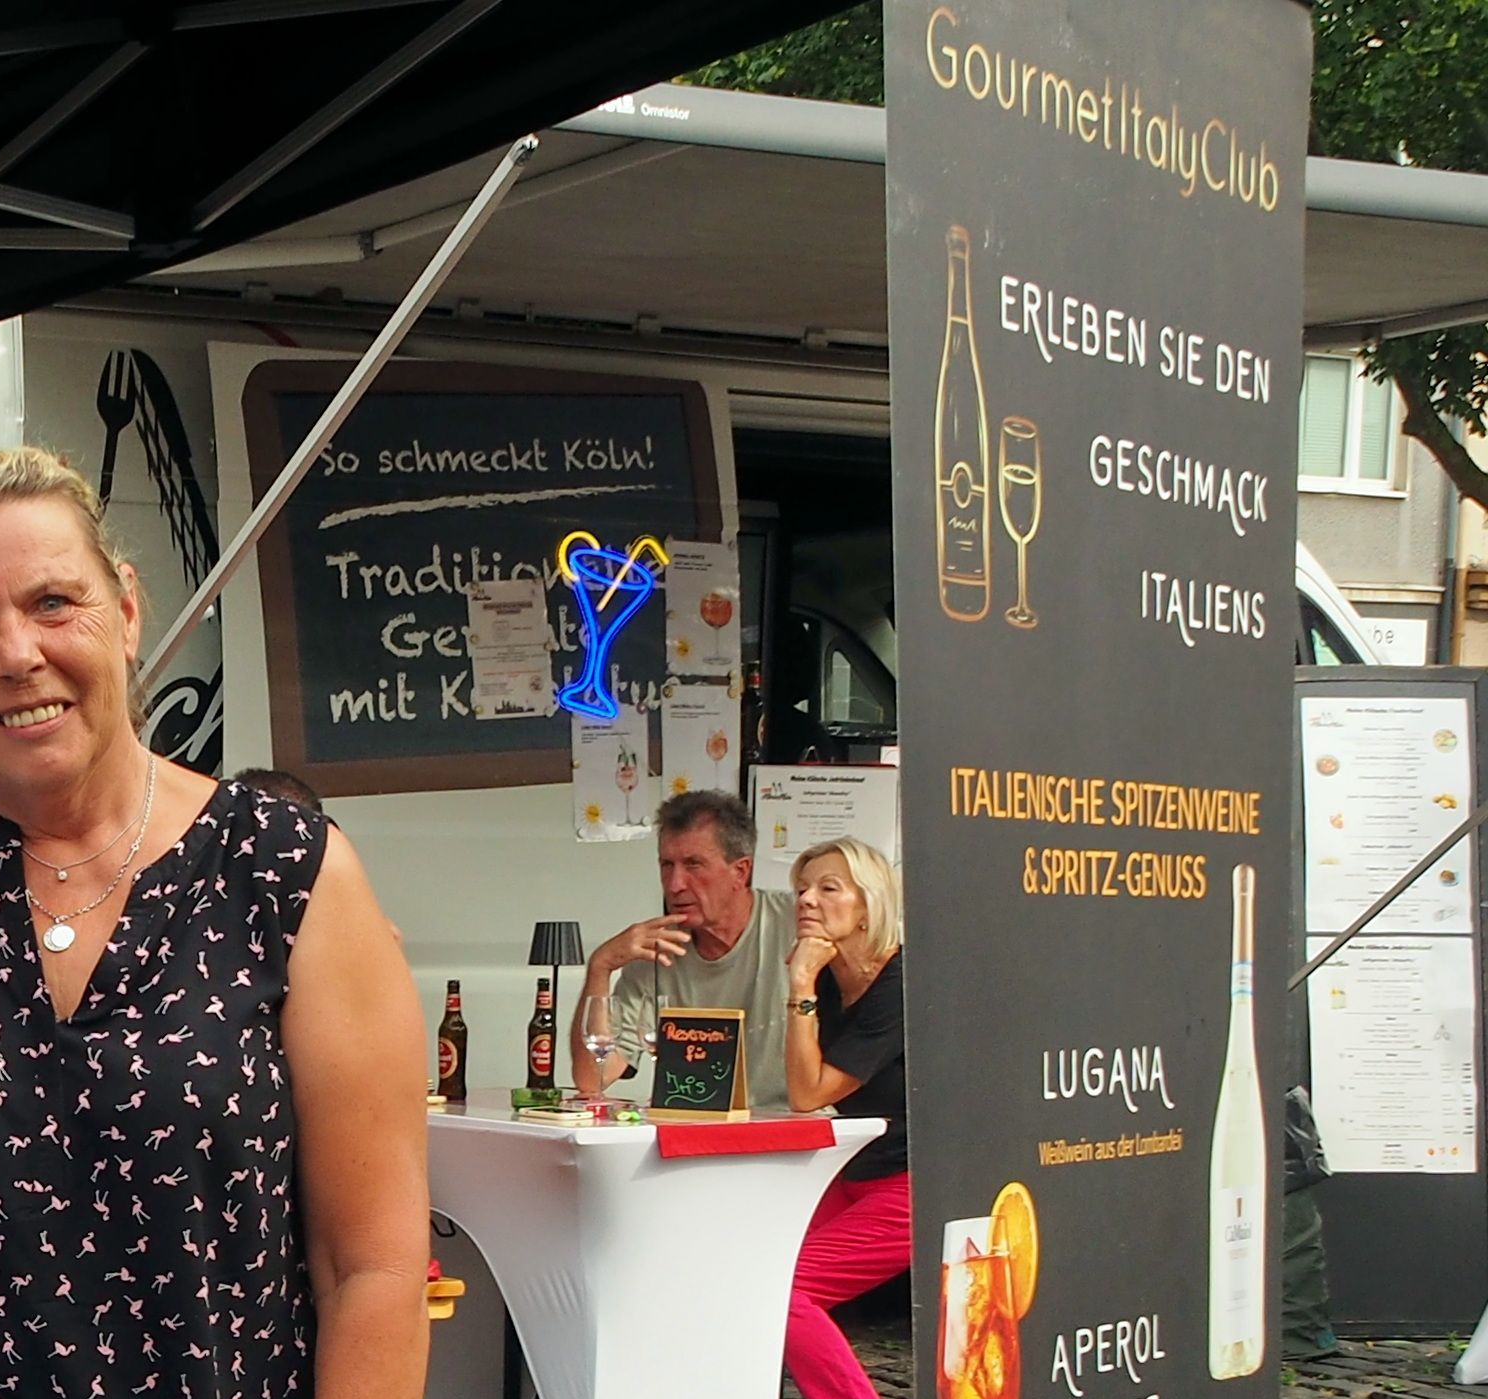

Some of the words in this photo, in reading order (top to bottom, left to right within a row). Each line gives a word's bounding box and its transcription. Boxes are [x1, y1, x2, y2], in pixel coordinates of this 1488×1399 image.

[926, 6, 1279, 212] GourmetItalyClub
[1000, 275, 1147, 367] ERLEBEN
[1159, 325, 1204, 386] SIE
[1216, 344, 1269, 404] DEN
[319, 440, 360, 477] So
[379, 439, 549, 475] schmeckt
[563, 436, 655, 472] Köln!
[1088, 434, 1267, 536] GESCHMACK
[1141, 570, 1266, 647] ITALIENS
[329, 671, 417, 724] mit
[950, 767, 1105, 825] ITALIENISCHE
[1111, 780, 1261, 835] SPITZENWEINE
[1023, 847, 1039, 894] &
[1041, 849, 1206, 899] SPRITZ-GENUSS
[1043, 1046, 1175, 1112] LUGANA
[1094, 1141, 1116, 1160] aus
[1117, 1133, 1135, 1158] der
[1051, 1314, 1165, 1397] APEROL
